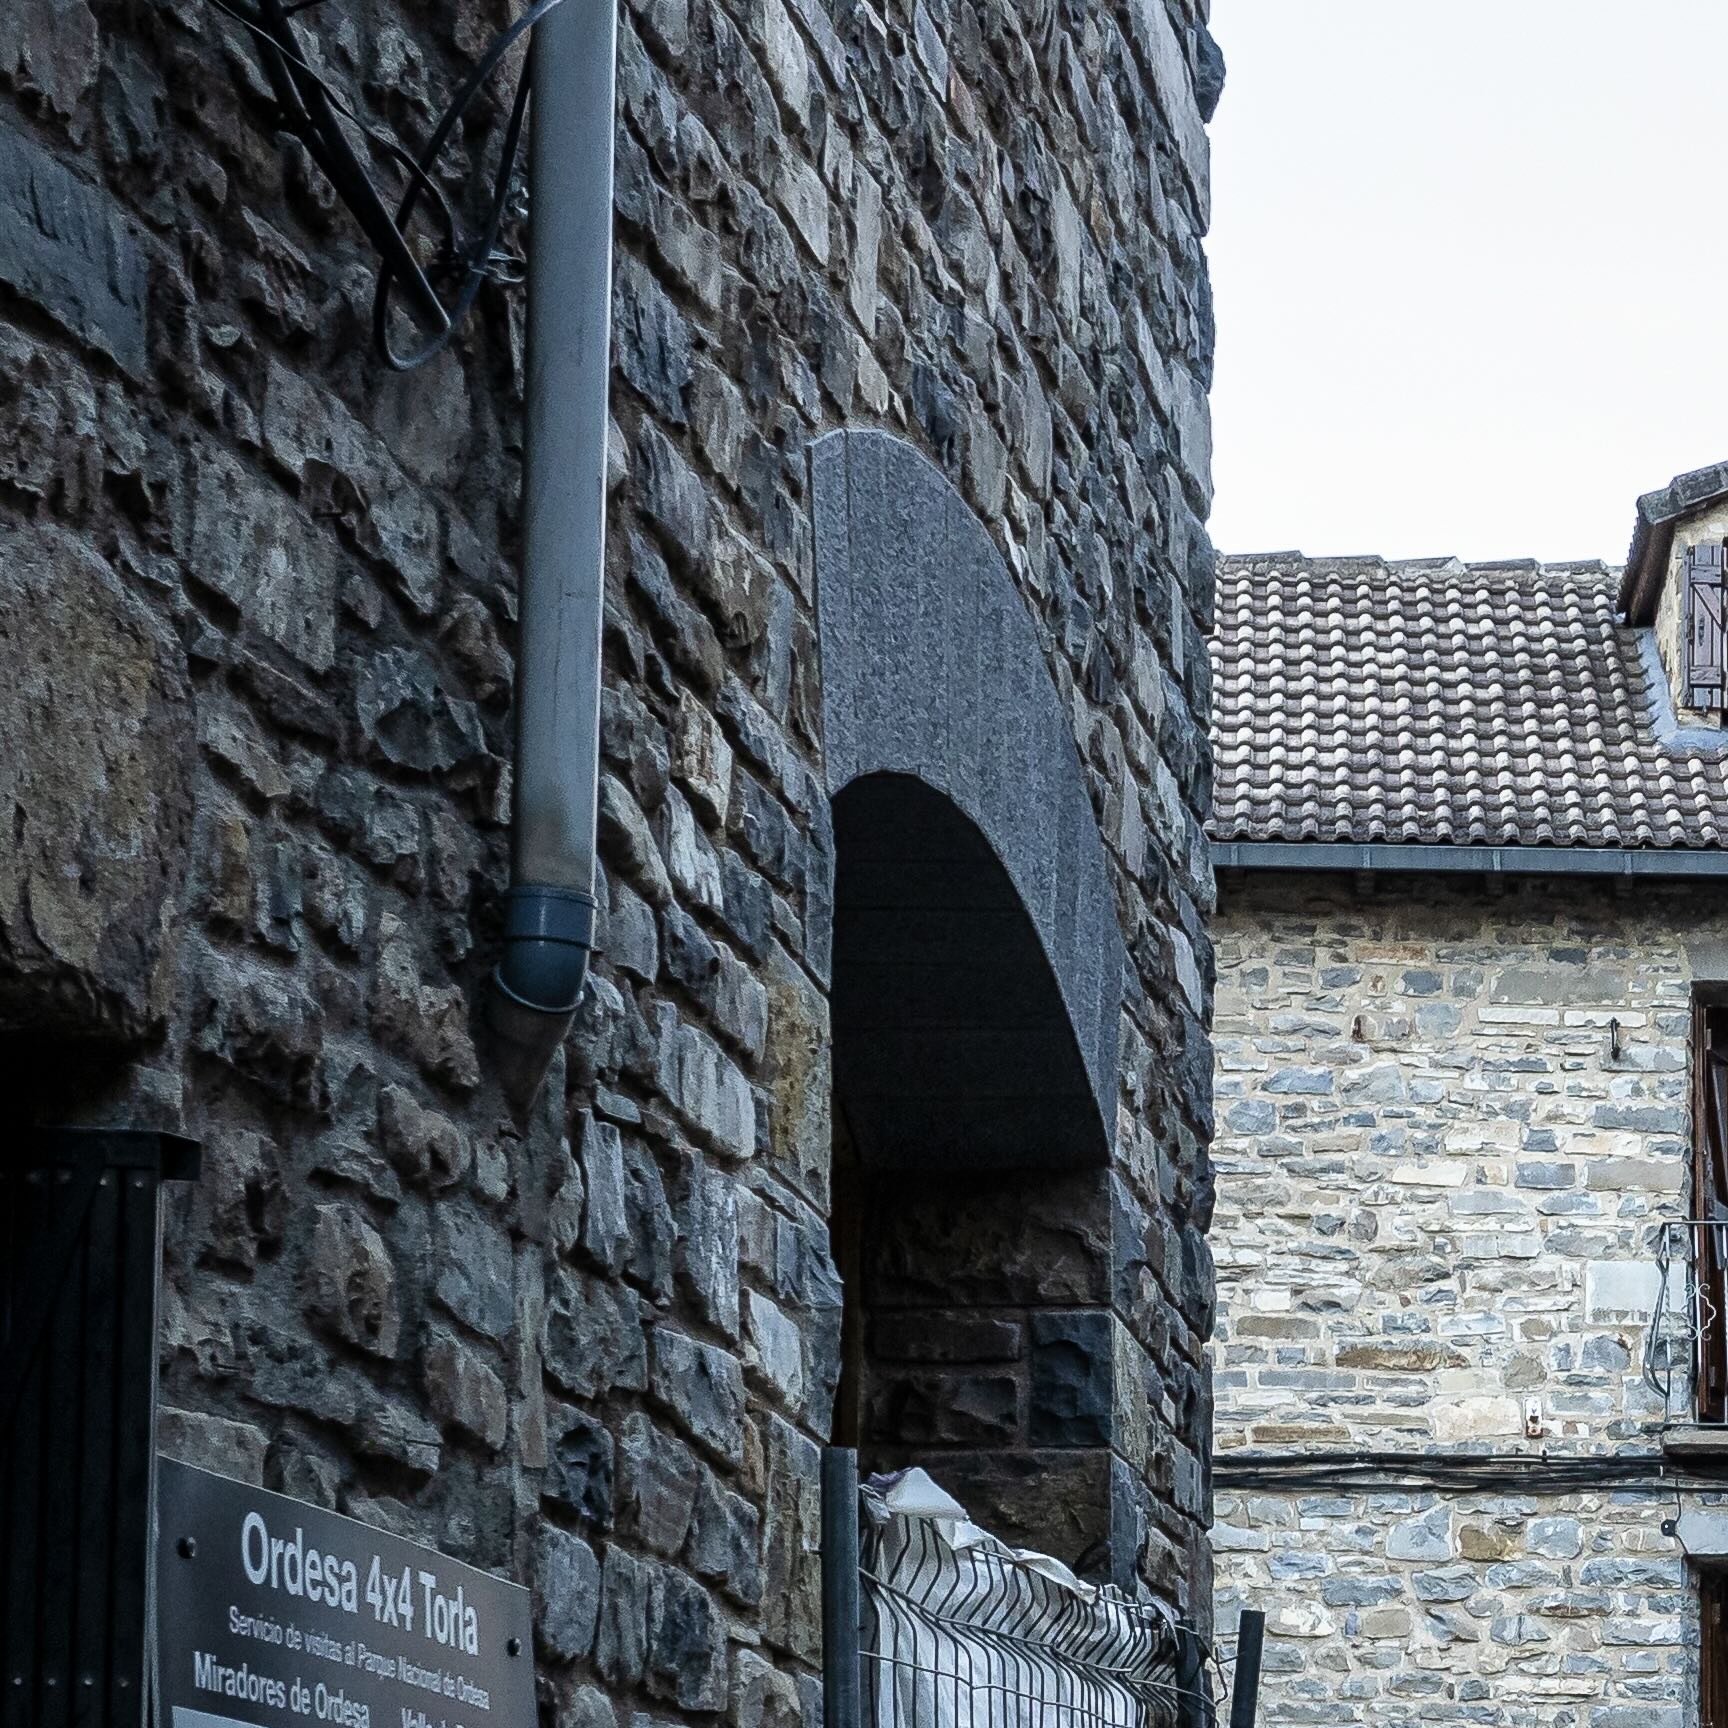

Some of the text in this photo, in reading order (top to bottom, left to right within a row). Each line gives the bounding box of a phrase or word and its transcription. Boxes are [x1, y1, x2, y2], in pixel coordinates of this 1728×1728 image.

[241, 1511, 480, 1656] Ordesa 4x4 Torla
[229, 1605, 283, 1645] Servicio
[286, 1621, 302, 1651] de
[192, 1650, 286, 1709] Miradores
[290, 1676, 312, 1716] de
